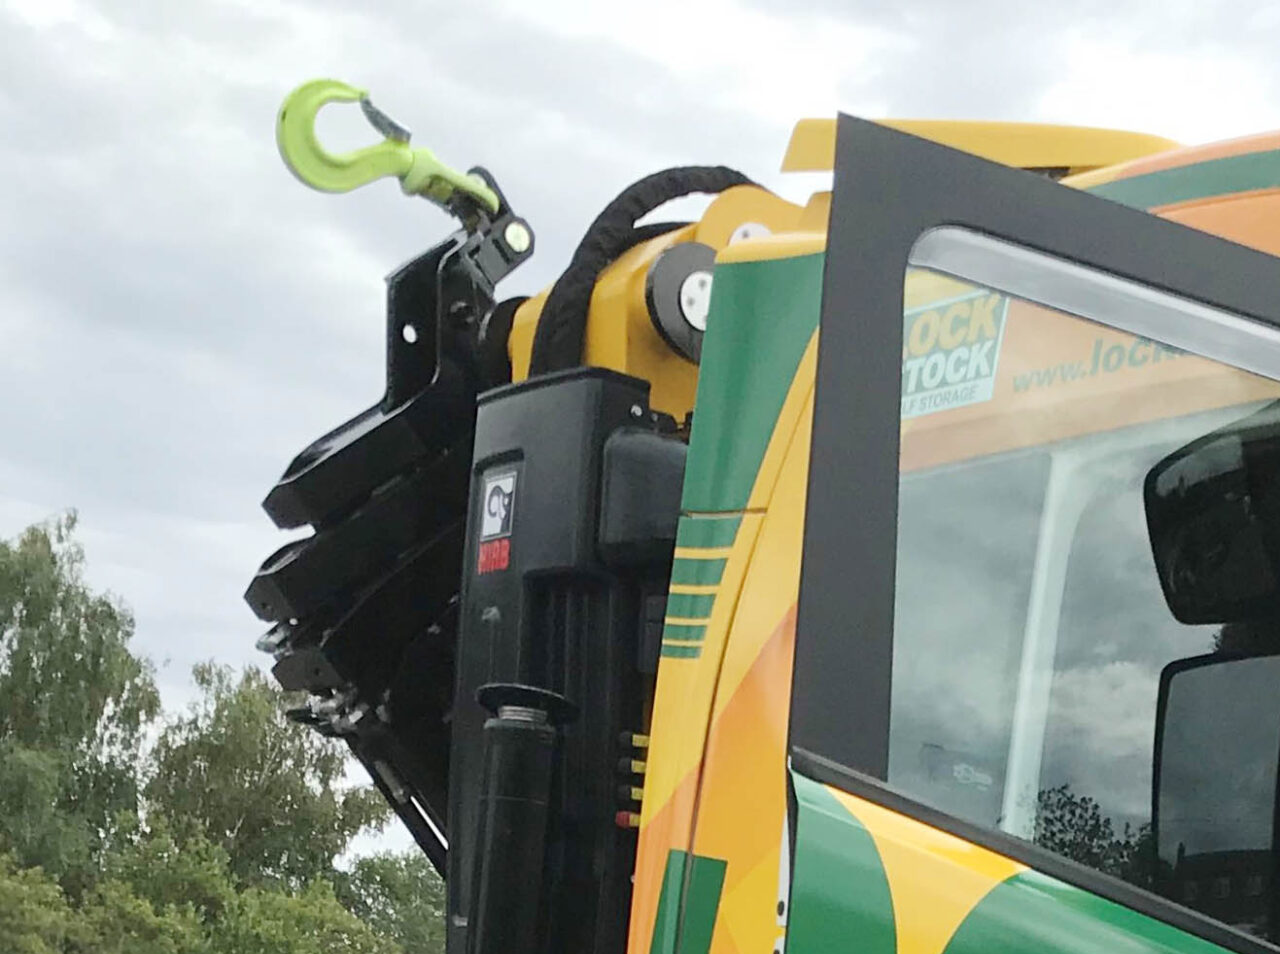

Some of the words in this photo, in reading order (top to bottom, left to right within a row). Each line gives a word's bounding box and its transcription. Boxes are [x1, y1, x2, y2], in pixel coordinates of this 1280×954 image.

[903, 293, 1001, 358] OCK
[902, 339, 995, 394] TOCK
[919, 385, 978, 411] STORAGE
